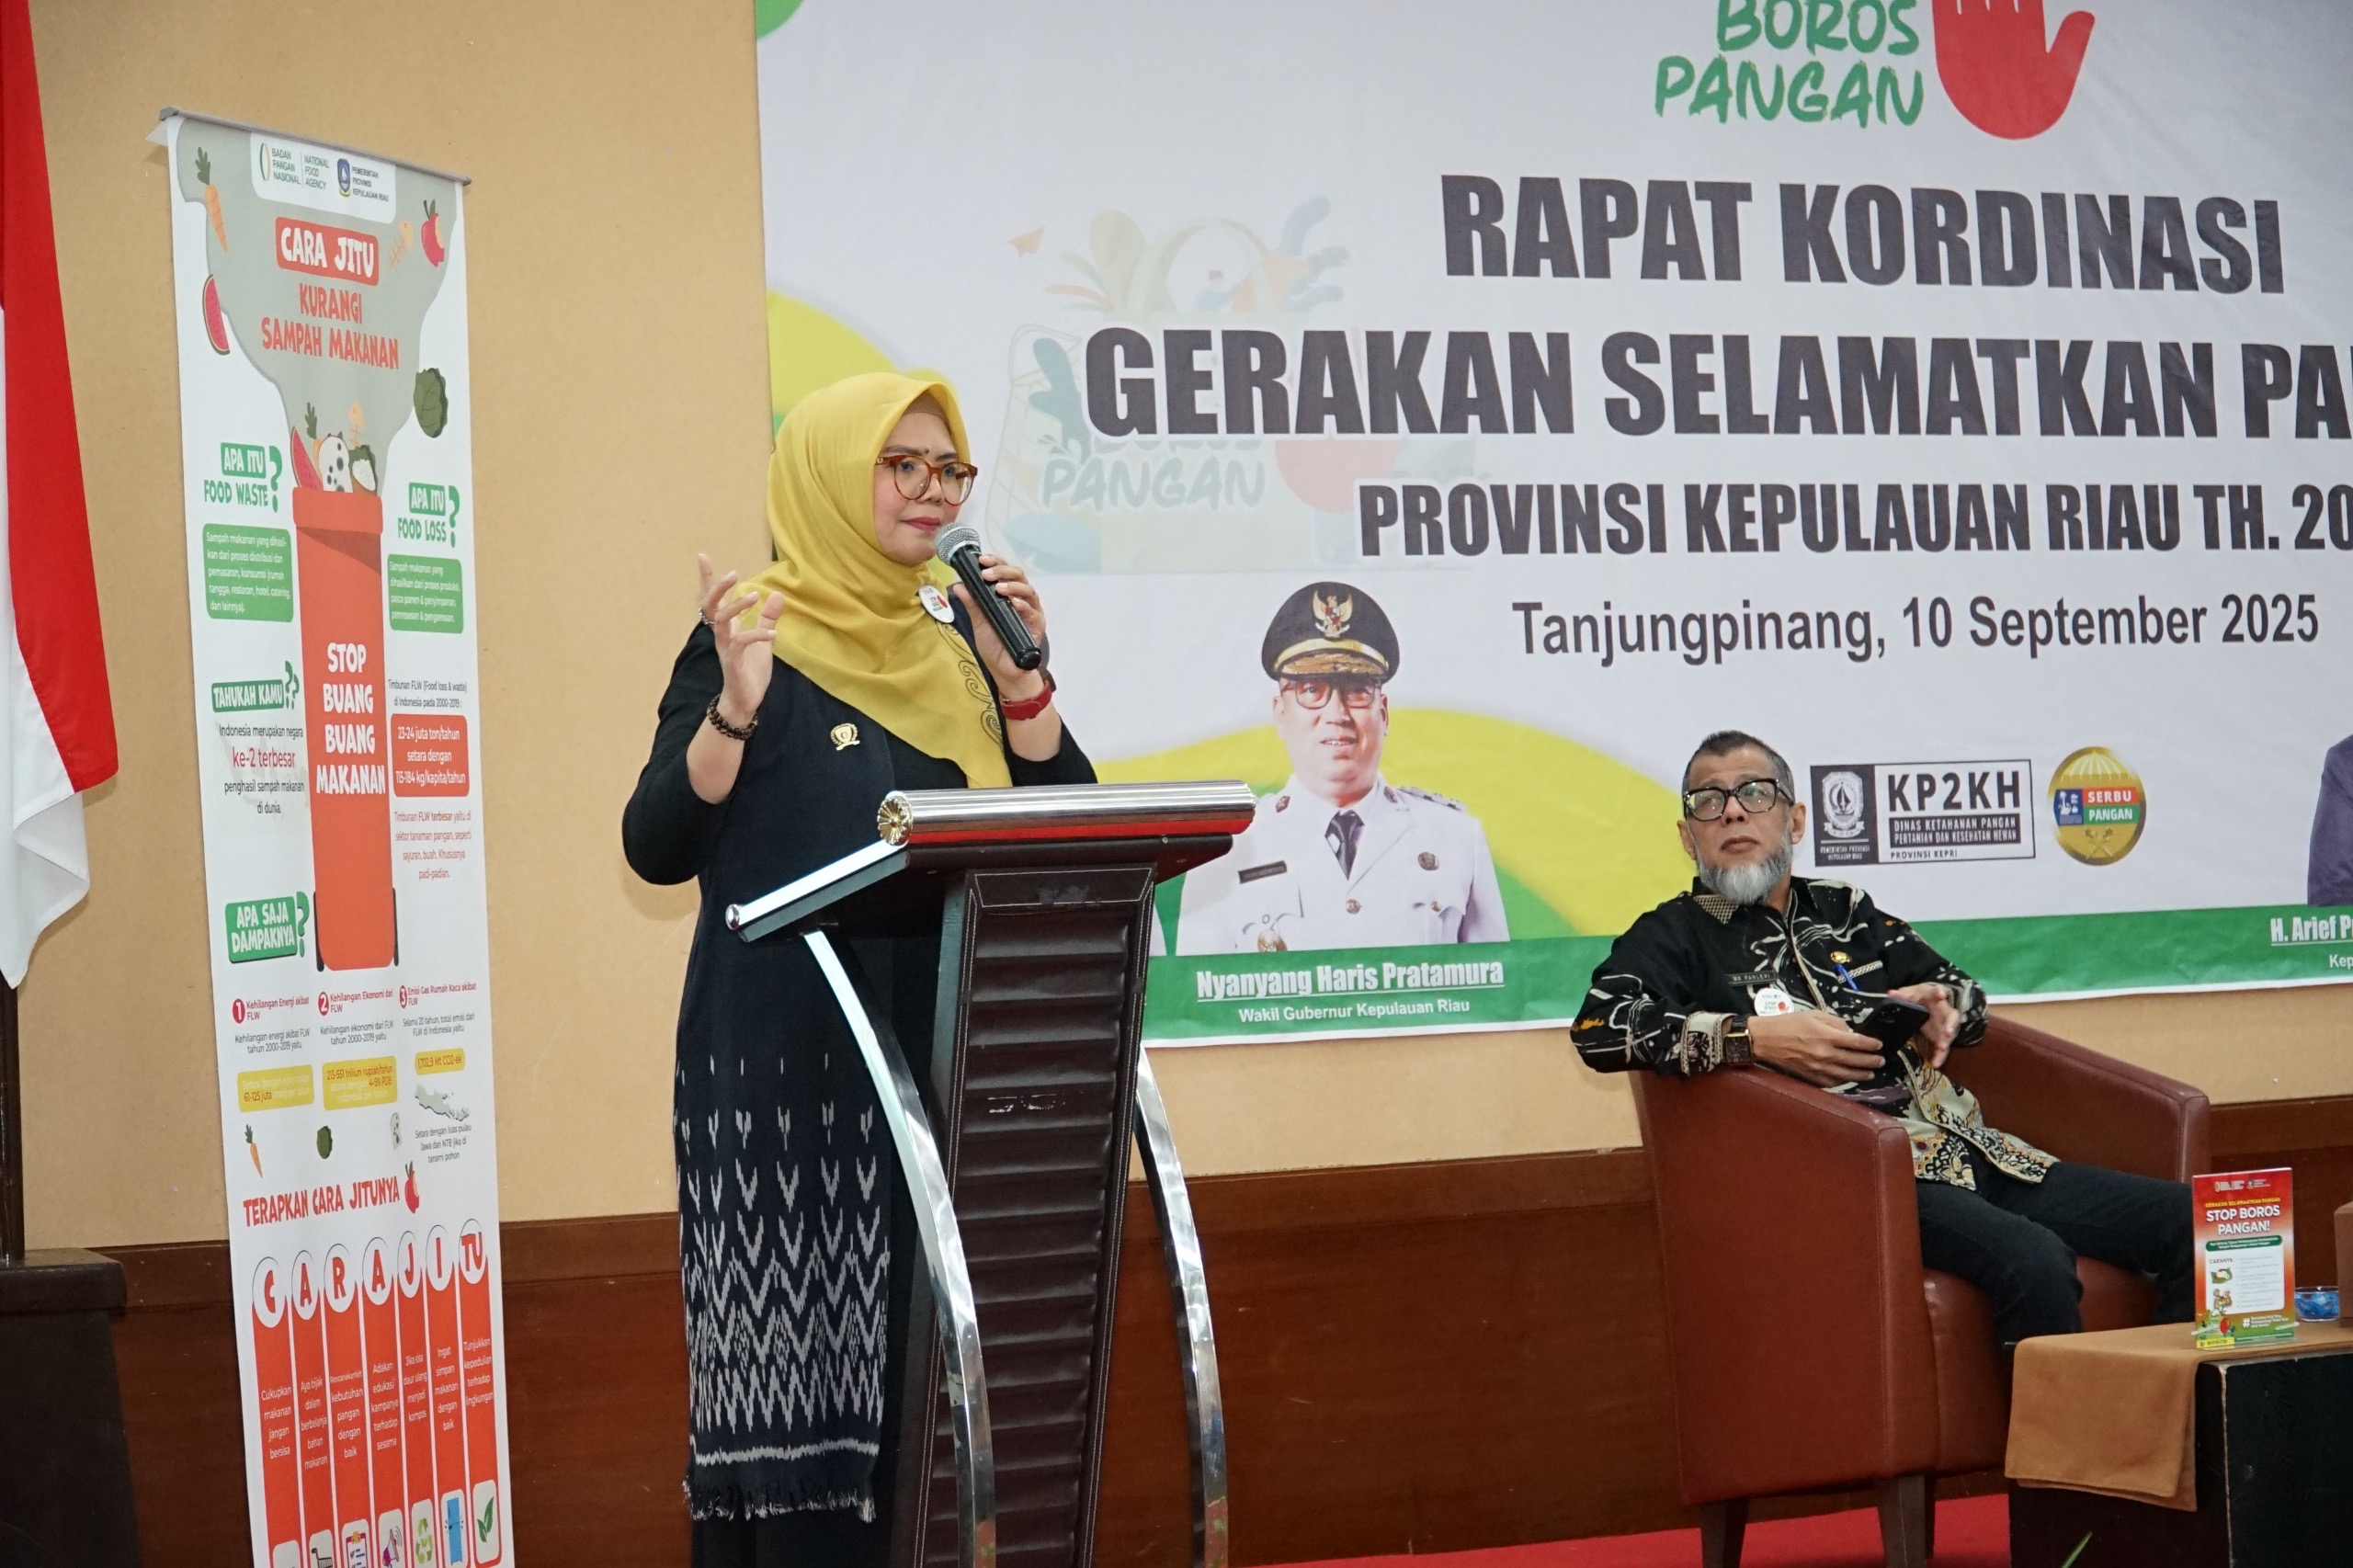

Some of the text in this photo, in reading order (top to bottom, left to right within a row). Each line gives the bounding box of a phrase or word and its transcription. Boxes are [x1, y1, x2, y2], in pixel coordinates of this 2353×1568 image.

[1717, 0, 1919, 55] BOROS
[1655, 54, 1924, 129] PANGAN
[272, 148, 291, 160] BADAN
[303, 154, 330, 168] NATIONAL
[273, 160, 295, 173] PANGAN
[304, 166, 319, 177] FOOD
[352, 166, 379, 178] PEMERINTAH
[273, 171, 301, 185] NASIONAL
[305, 178, 326, 190] AGENCY
[352, 177, 372, 187] PROVINSI
[379, 192, 389, 201] RIAU
[1440, 175, 2285, 294] RAPAT KORDINASI
[280, 226, 374, 278] CARA JITU
[299, 282, 363, 324] KURANGI
[260, 316, 399, 369] SAMPAH MAKANAN
[1086, 327, 2353, 439] GERAKAN SELAMATKAN PA
[223, 447, 264, 474] APA ITU
[1042, 456, 1266, 512] PANGAN
[203, 480, 268, 506] FOOD WASTE
[411, 486, 444, 512] APA ITU
[1358, 483, 2353, 556] PROVINSI KEPULAUAN RIAU TH. 20
[398, 517, 447, 542] FOOD LOSS
[1513, 593, 2319, 667] Tanjungpinang, 10 September 2025
[327, 642, 367, 673] STOP
[411, 680, 423, 690] FLW
[423, 680, 438, 692] (Food
[438, 681, 448, 691] loss
[213, 684, 283, 708] TAHUKAH KAMU
[323, 683, 373, 714] BUANG
[394, 696, 399, 707] di
[399, 697, 422, 708] Indonesia
[423, 699, 436, 709] pada
[220, 723, 303, 741] Indonesia merupakan negara
[324, 724, 375, 755] BUANG
[398, 725, 460, 743] 23-24 juta ton/tahun
[233, 746, 295, 768] ke-2 terbesar
[407, 748, 452, 765] setara dengan
[316, 764, 386, 795] MAKANAN
[415, 768, 466, 787] kg/kapita/tahun
[224, 779, 304, 795] penghasil sampah makanan
[1887, 770, 2020, 812] KP2KH
[2087, 790, 2131, 803] SERBU
[257, 801, 264, 814] di
[2088, 808, 2133, 821] PANGAN
[1893, 816, 2017, 832] DINAS KETAHANAN PANGAN
[1894, 829, 2017, 845] PERTANIAN DAN KESEHATAN HEWAN
[1891, 848, 1958, 860] PROVINSI KEPRI
[236, 901, 290, 929] APA SAJA
[2270, 914, 2353, 943] H. Arief P
[231, 924, 295, 954] DAMPAKNYA
[1197, 961, 1504, 1000] Nyanyang Haris Pratamura
[246, 995, 310, 1011] Kehilangan Energi akibat
[330, 992, 362, 1004] Kehilangan
[362, 990, 385, 1001] Ekonomi
[247, 1011, 260, 1021] FLW
[331, 1004, 343, 1014] FLW
[1239, 998, 1471, 1024] Wakil Gubernur Kepulauan Riau
[243, 1176, 401, 1227] TERAPKAN CARA JITUNYA
[2206, 1205, 2281, 1222] STOP BOROS
[2218, 1220, 2270, 1235] PANGAN!
[264, 1232, 483, 1314] C A R A J I TU
[438, 1346, 451, 1358] Ingat
[463, 1338, 491, 1352] Tunjukkan
[372, 1362, 393, 1374] Adakan
[464, 1356, 493, 1370] kepedulian
[436, 1365, 455, 1377] simpan
[301, 1376, 324, 1393] Ayo bijak
[467, 1374, 491, 1387] terhadap
[261, 1387, 292, 1401] Cukupkan
[331, 1388, 363, 1403] kebutuhan
[434, 1382, 459, 1395] makanan
[305, 1398, 322, 1411] dalam
[371, 1399, 399, 1413] kampanye
[438, 1402, 458, 1414] dengan
[264, 1406, 292, 1421] makanan
[337, 1409, 360, 1424] pangan
[301, 1415, 327, 1431] berbelanja
[373, 1418, 398, 1432] terhadap
[443, 1419, 455, 1431] baik
[268, 1426, 290, 1443] jangan
[338, 1428, 361, 1440] dengan
[307, 1437, 324, 1449] bahan
[377, 1437, 397, 1450] sesama
[269, 1445, 290, 1460] bersisa
[344, 1446, 358, 1458] baik
[304, 1456, 328, 1470] makanan
